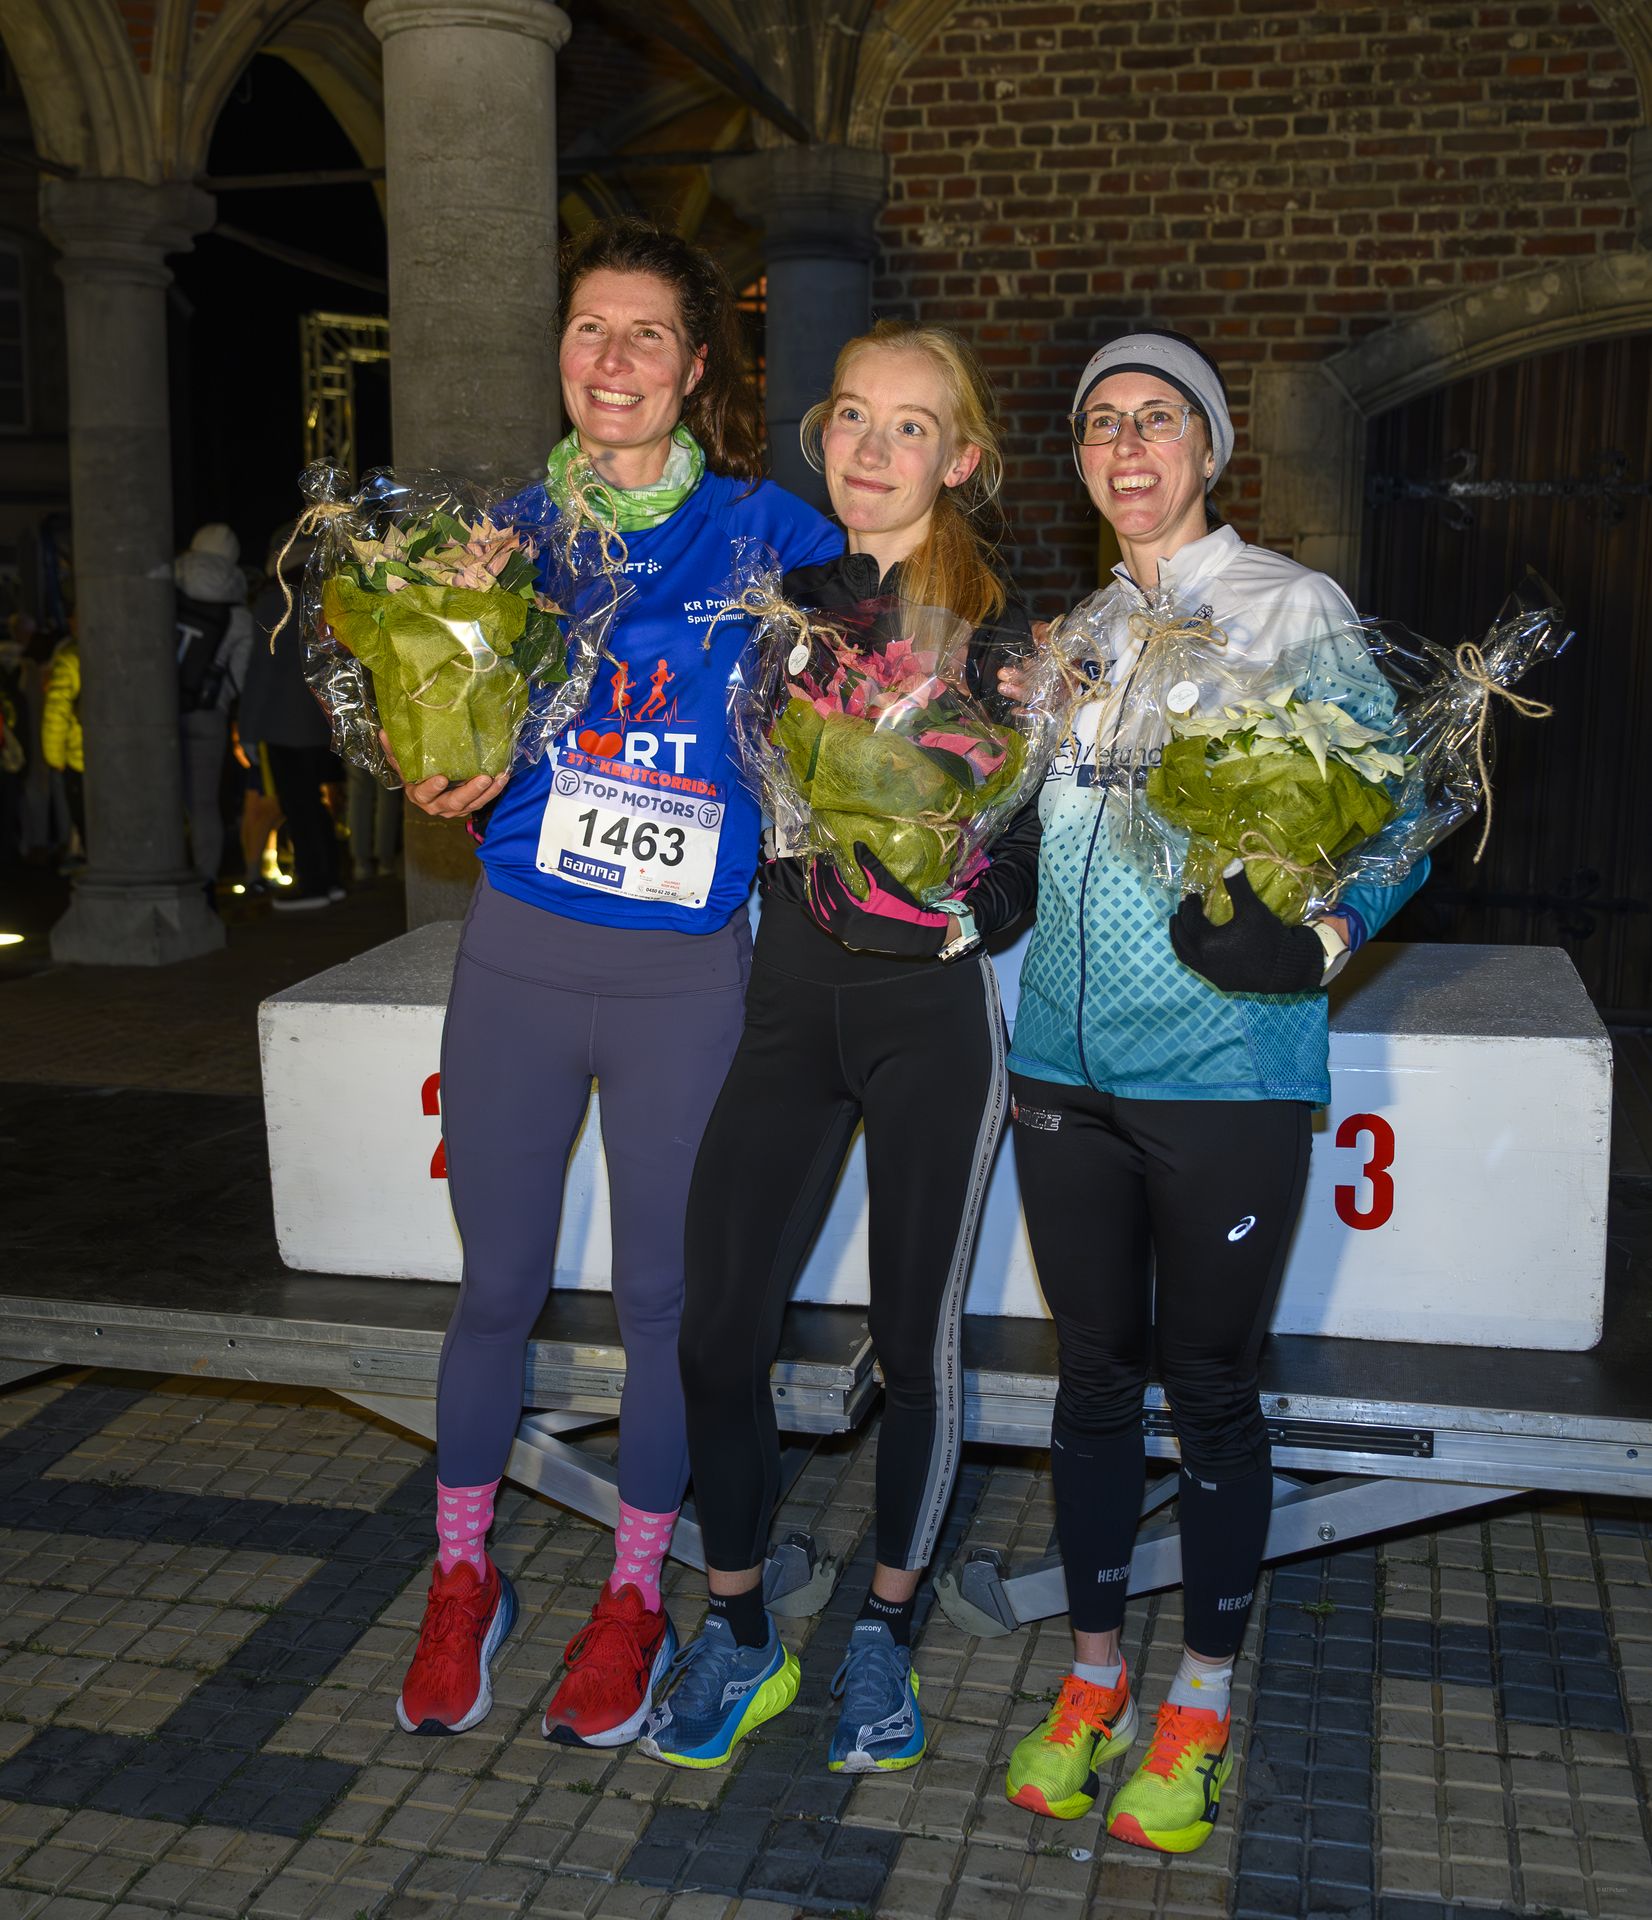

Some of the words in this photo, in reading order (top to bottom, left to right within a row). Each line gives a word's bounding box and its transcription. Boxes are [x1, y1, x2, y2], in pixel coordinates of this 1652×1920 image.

[599, 562, 646, 574] RAFT
[684, 600, 703, 612] KR
[599, 761, 717, 797] KERSTCORRIDA
[583, 781, 618, 801] TOP
[622, 791, 695, 818] MOTORS
[578, 808, 686, 867] 1463
[1334, 1112, 1396, 1231] 3
[947, 1385, 955, 1411] NIKE
[947, 1418, 955, 1444] NIKE
[943, 1449, 953, 1474] NIKE
[936, 1480, 947, 1504] NIKE
[928, 1508, 940, 1532] NIKE
[921, 1538, 932, 1561] NIKE
[869, 1597, 904, 1615] KIPRUN
